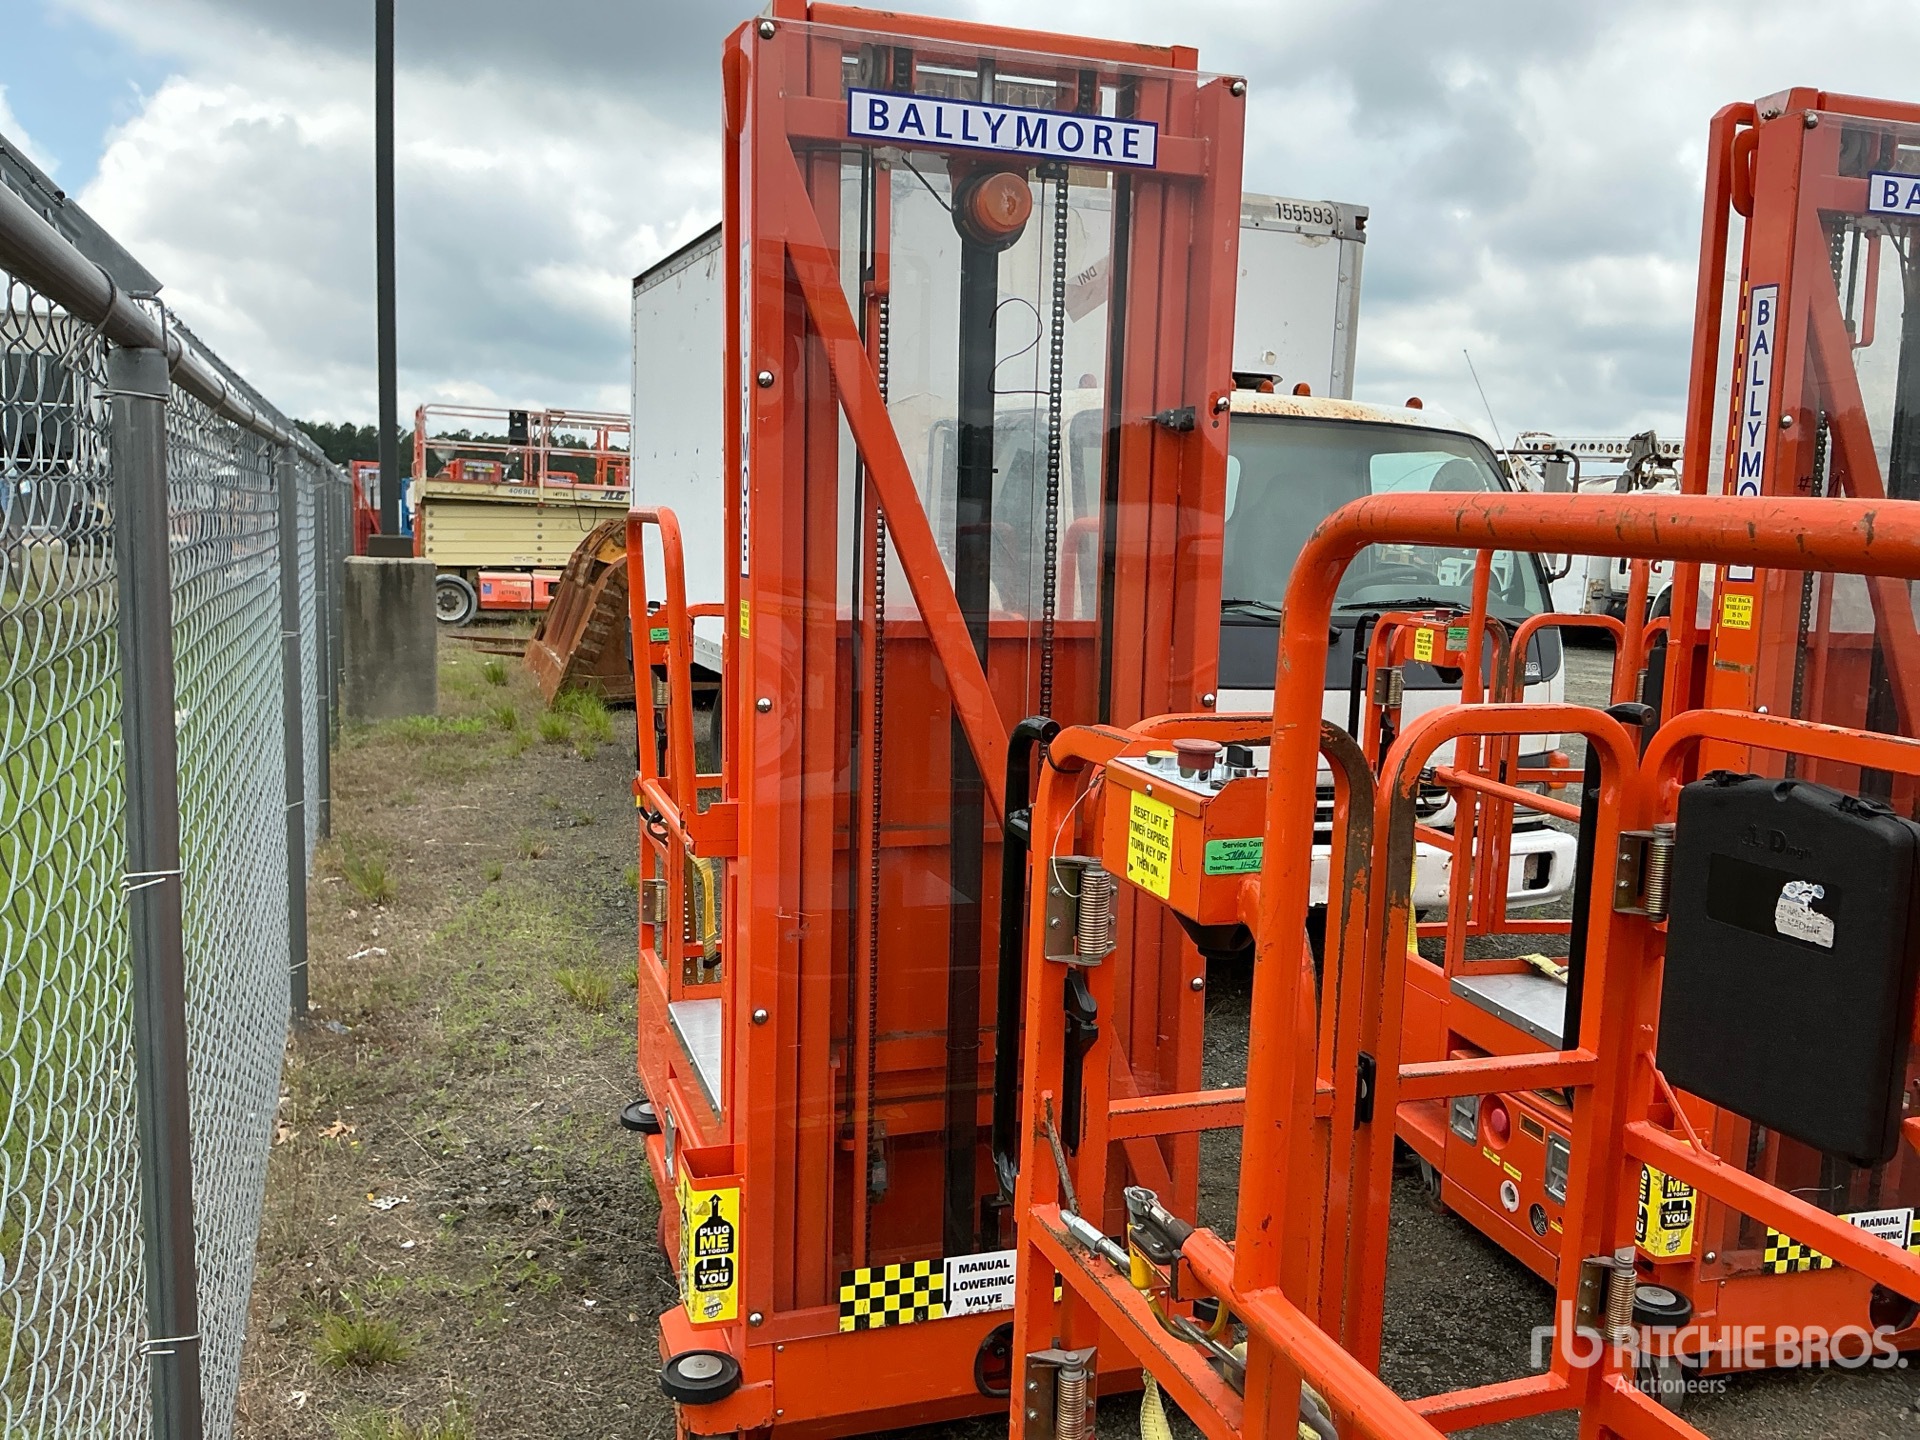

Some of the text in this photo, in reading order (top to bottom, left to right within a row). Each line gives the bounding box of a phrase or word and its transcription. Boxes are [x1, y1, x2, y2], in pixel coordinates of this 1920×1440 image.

[868, 98, 1140, 159] BALLYMORE
[1275, 202, 1334, 225] 155593
[600, 490, 626, 501] JLG
[1133, 805, 1169, 830] RESET LIFT IF
[1130, 819, 1146, 837] TIMER
[1131, 836, 1168, 864] TURN KEY OFF
[1222, 841, 1248, 849] Service
[1136, 856, 1150, 873] THEN
[1665, 1214, 1688, 1223] YOU
[1860, 1216, 1901, 1228] MANUAL
[699, 1225, 730, 1237] PLUG
[700, 1233, 730, 1250] ME
[958, 1258, 1011, 1274] MANUAL
[699, 1272, 729, 1285] YOU
[952, 1274, 1015, 1292] LOWERING
[964, 1293, 1003, 1307] VALVE
